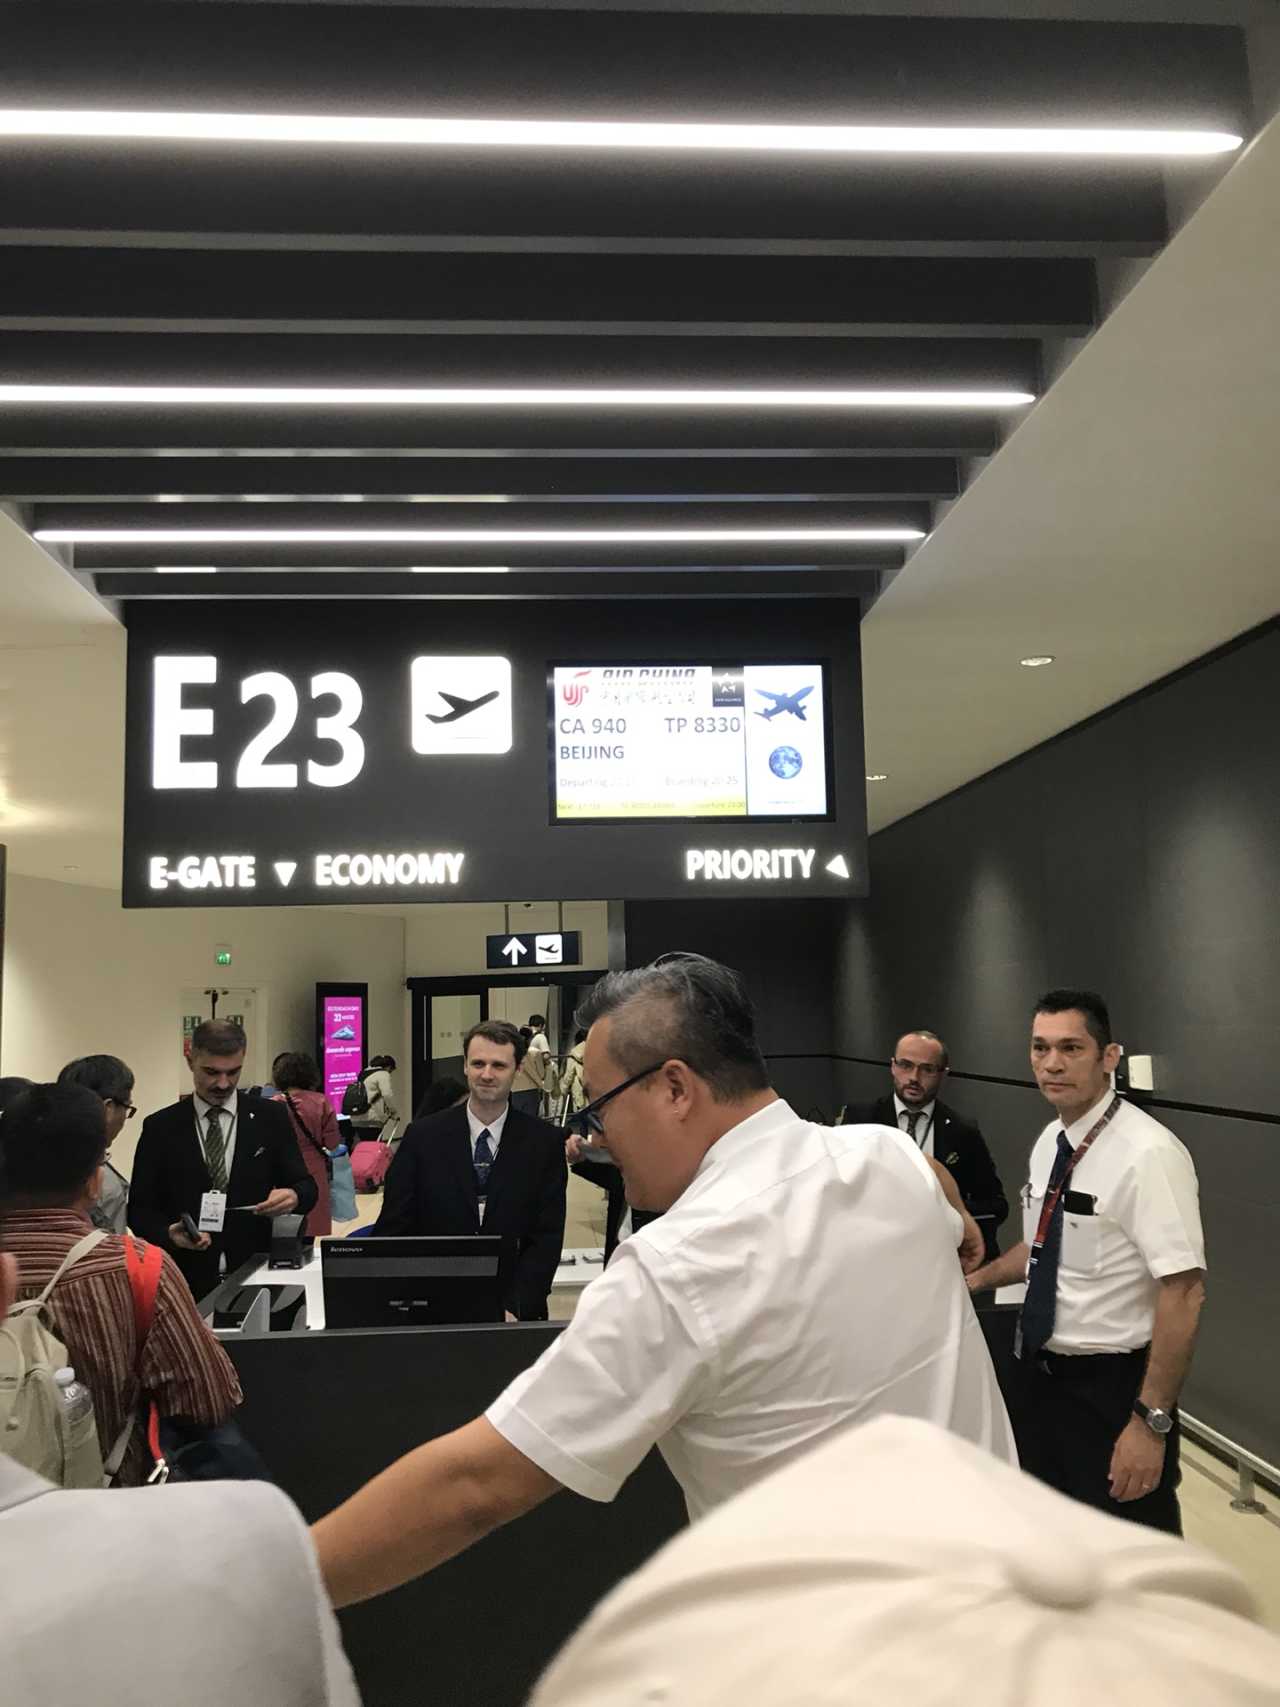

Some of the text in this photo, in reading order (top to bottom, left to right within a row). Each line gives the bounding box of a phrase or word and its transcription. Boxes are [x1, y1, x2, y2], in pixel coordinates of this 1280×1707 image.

[559, 718, 627, 734] CA 940
[664, 717, 741, 733] TP 8330
[560, 745, 625, 760] BEIJING
[149, 852, 465, 889] E-GATE ECONOMY
[686, 848, 816, 880] PRIORITY
